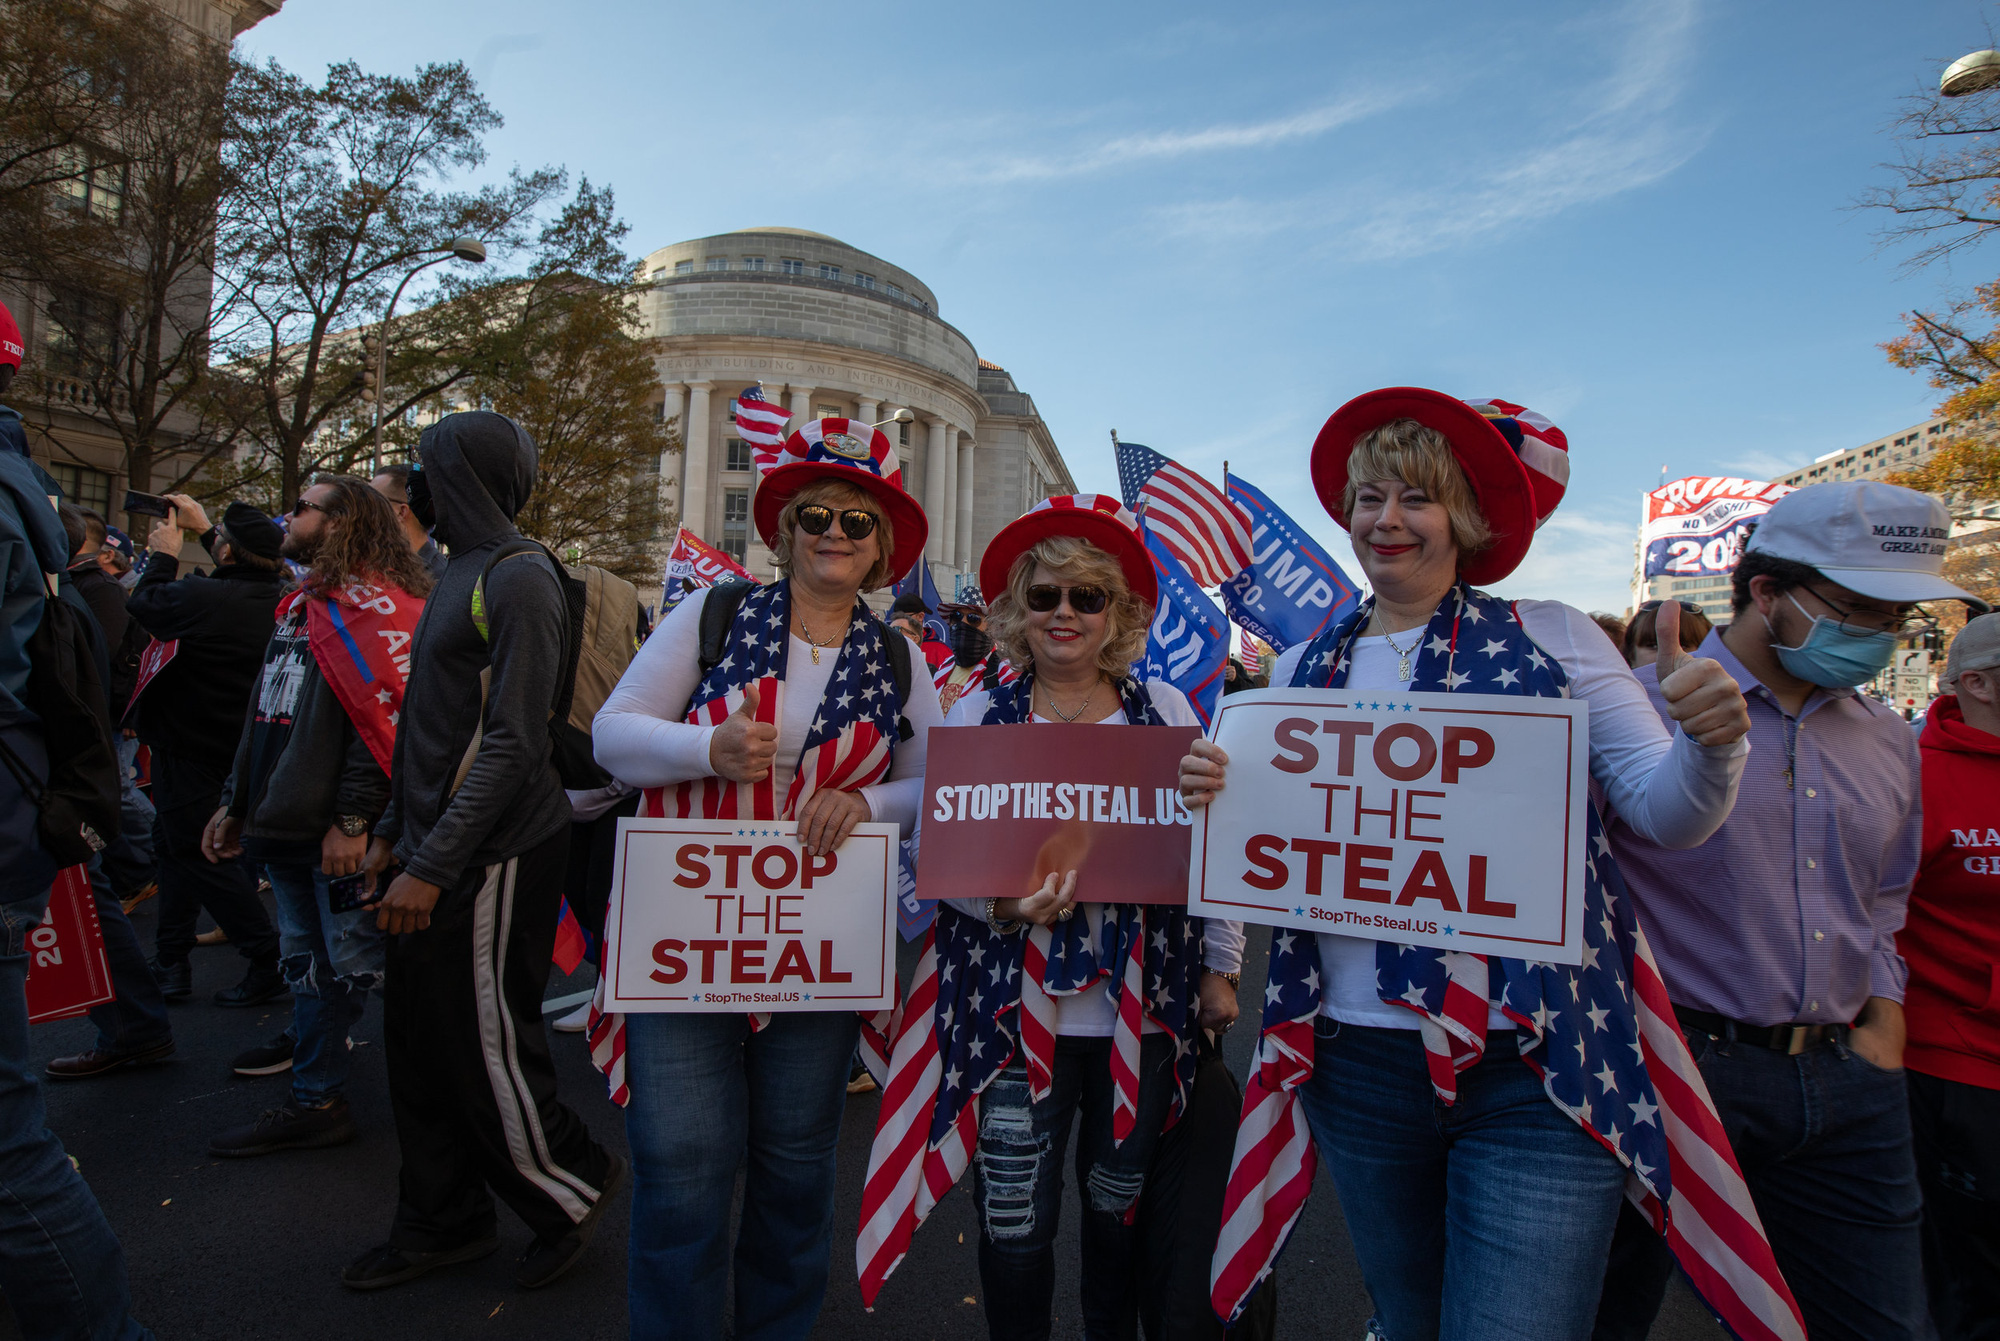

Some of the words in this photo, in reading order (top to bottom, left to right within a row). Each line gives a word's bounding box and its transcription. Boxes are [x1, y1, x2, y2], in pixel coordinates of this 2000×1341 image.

[660, 360, 713, 369] REAGAN
[723, 359, 794, 371] BUILDING
[807, 364, 835, 376] AND
[847, 370, 939, 401] INTERNATIONAL
[1682, 519, 1700, 529] NO
[1872, 525, 1919, 537] MAKE
[1228, 495, 1334, 609] UMP
[1664, 525, 1750, 572] 202
[1881, 541, 1928, 554] GREAT
[1270, 717, 1495, 784] STOP
[933, 783, 1192, 825] STOPTHESTEAL.US
[1310, 782, 1446, 843] THE
[1950, 828, 2000, 848] MA
[673, 843, 838, 890] STOP
[1241, 834, 1517, 919] STEAL
[704, 895, 805, 934] THE
[649, 938, 853, 985] STEAL
[704, 992, 800, 1004] StopTheSteal.US
